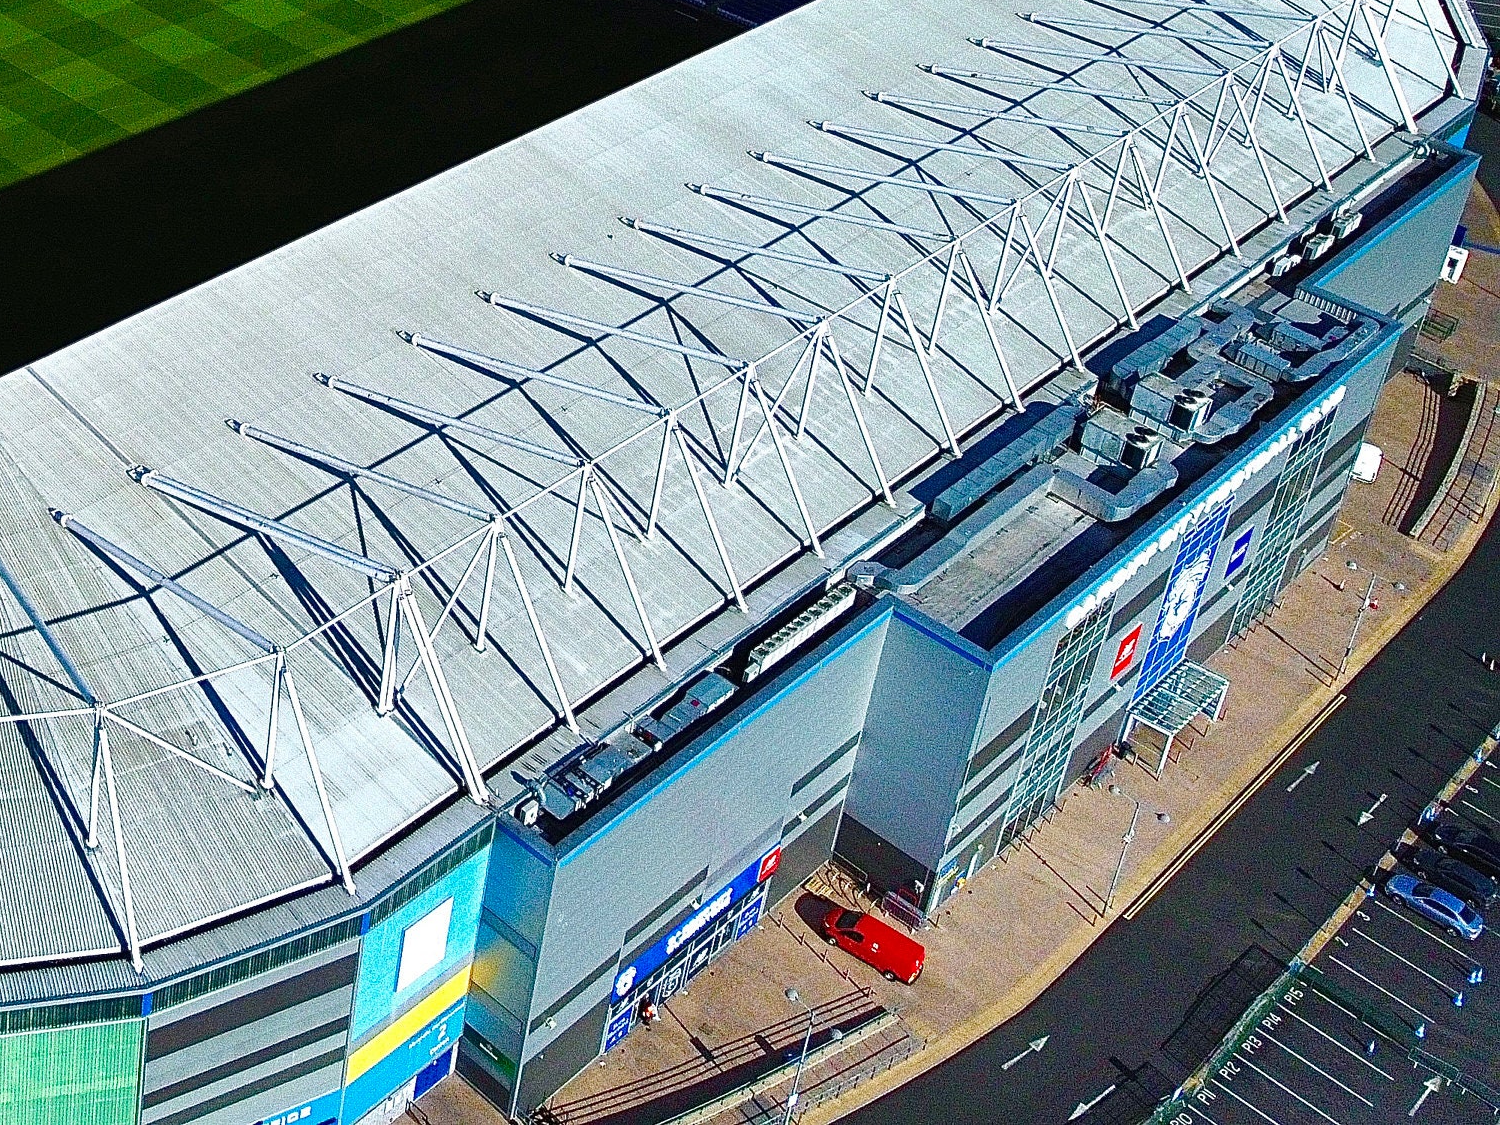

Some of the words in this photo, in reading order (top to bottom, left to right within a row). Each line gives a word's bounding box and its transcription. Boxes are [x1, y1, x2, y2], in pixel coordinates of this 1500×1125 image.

[1466, 784, 1479, 794] 8
[1357, 911, 1370, 922] 3
[1335, 936, 1348, 947] 2
[1284, 988, 1304, 1006] P15
[1262, 1014, 1282, 1031] P14
[437, 1023, 447, 1040] 2
[1242, 1035, 1262, 1054] P13
[1219, 1061, 1241, 1081] P12
[1197, 1089, 1216, 1106] P11
